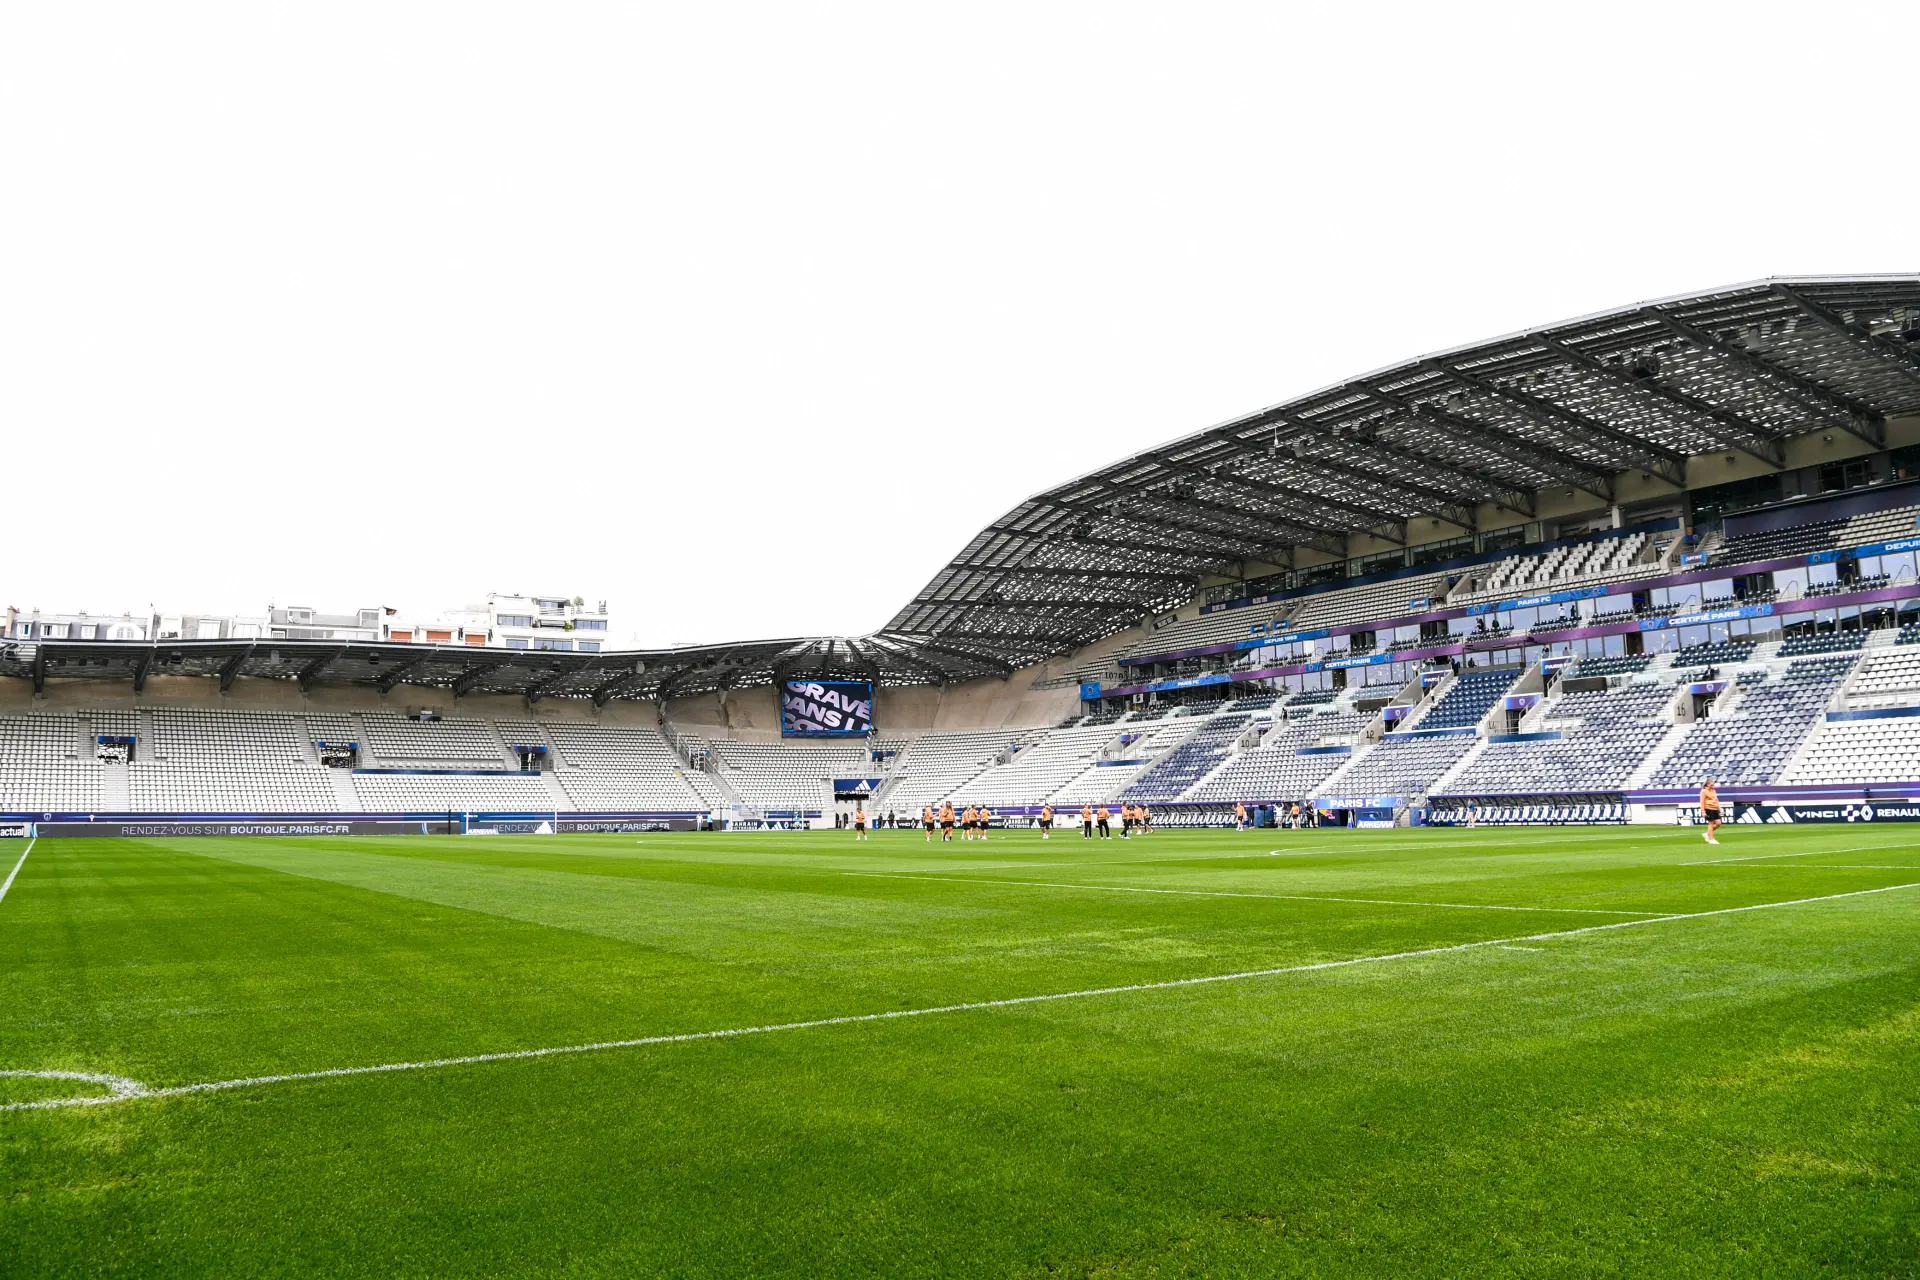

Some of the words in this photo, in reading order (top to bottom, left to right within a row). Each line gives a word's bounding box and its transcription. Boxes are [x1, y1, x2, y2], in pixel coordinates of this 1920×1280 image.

[1885, 539, 1920, 551] DEPUI
[1517, 597, 1540, 606] PARIS
[1668, 612, 1709, 625] CERTIFIÉ
[1712, 610, 1741, 620] PARIS
[1330, 799, 1363, 808] PARIS
[1365, 799, 1381, 807] FC
[1795, 810, 1839, 819] VINCI
[556, 823, 576, 832] SUR
[1357, 820, 1395, 829] ARKEMA
[121, 826, 202, 835] RENDEZ-VOUS
[204, 826, 227, 834] SUR
[230, 825, 349, 834] BOUTIQUE.PARISFC.FR
